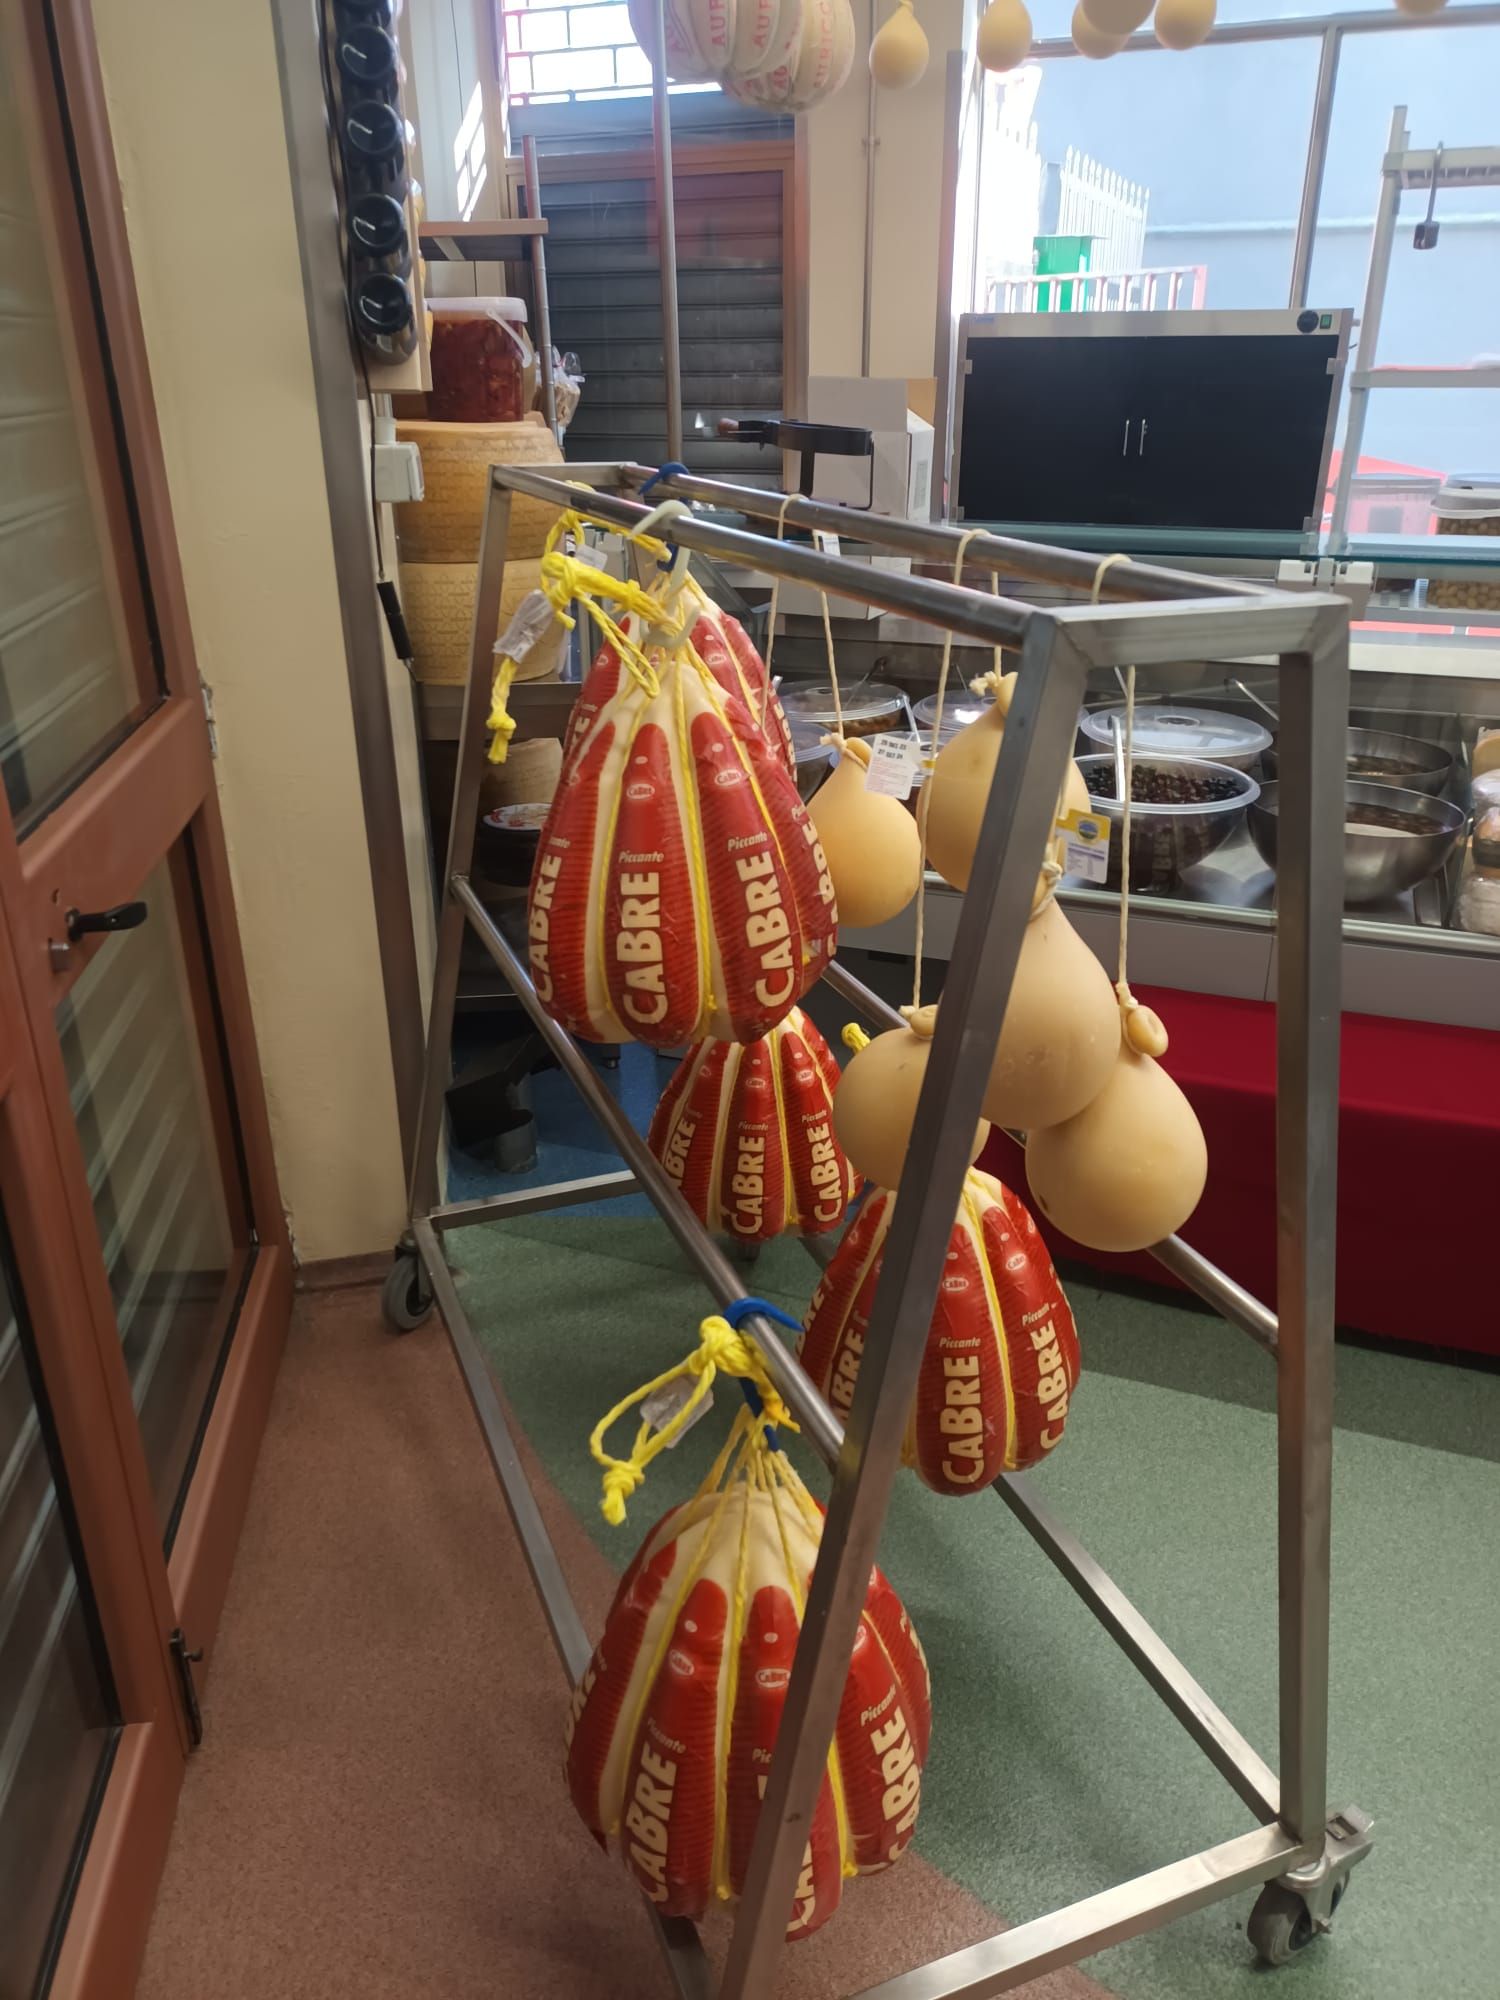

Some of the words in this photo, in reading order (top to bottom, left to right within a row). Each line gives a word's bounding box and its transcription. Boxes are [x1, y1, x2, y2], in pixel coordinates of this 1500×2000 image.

[618, 851, 665, 864] Piccante
[727, 831, 768, 852] Piccante
[529, 855, 563, 1003] CABRE
[616, 872, 669, 1025] CABRE
[736, 850, 795, 1008] CABRE
[731, 1136, 765, 1235] CABRE
[809, 1122, 843, 1223] CABRE
[938, 1337, 982, 1349] Piccante
[1029, 1319, 1070, 1450] CABRE
[939, 1355, 985, 1485] CABRE
[625, 1741, 678, 1903] CABRE
